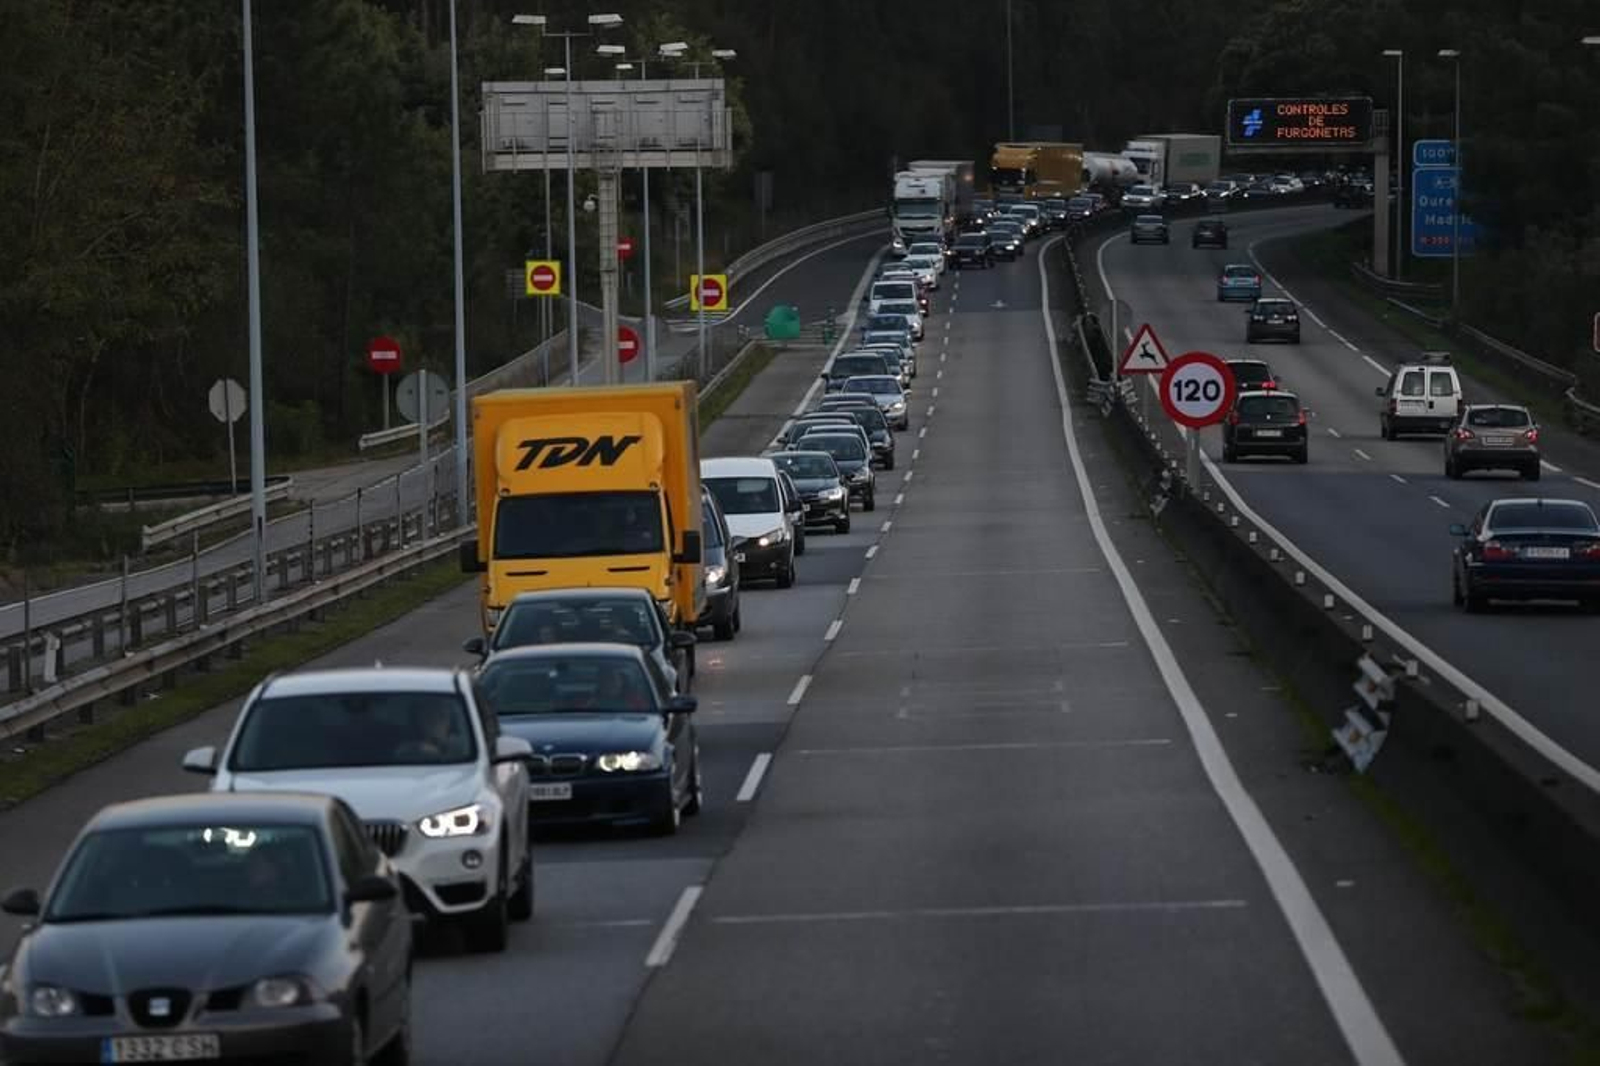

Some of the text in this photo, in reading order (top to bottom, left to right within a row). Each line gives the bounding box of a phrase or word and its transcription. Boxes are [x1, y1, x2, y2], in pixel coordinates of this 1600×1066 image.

[1276, 103, 1349, 115] CONTROLES
[1308, 116, 1325, 126] DE
[1276, 127, 1357, 138] FURGONETAS
[1173, 379, 1221, 402] 120
[514, 435, 644, 472] TDN
